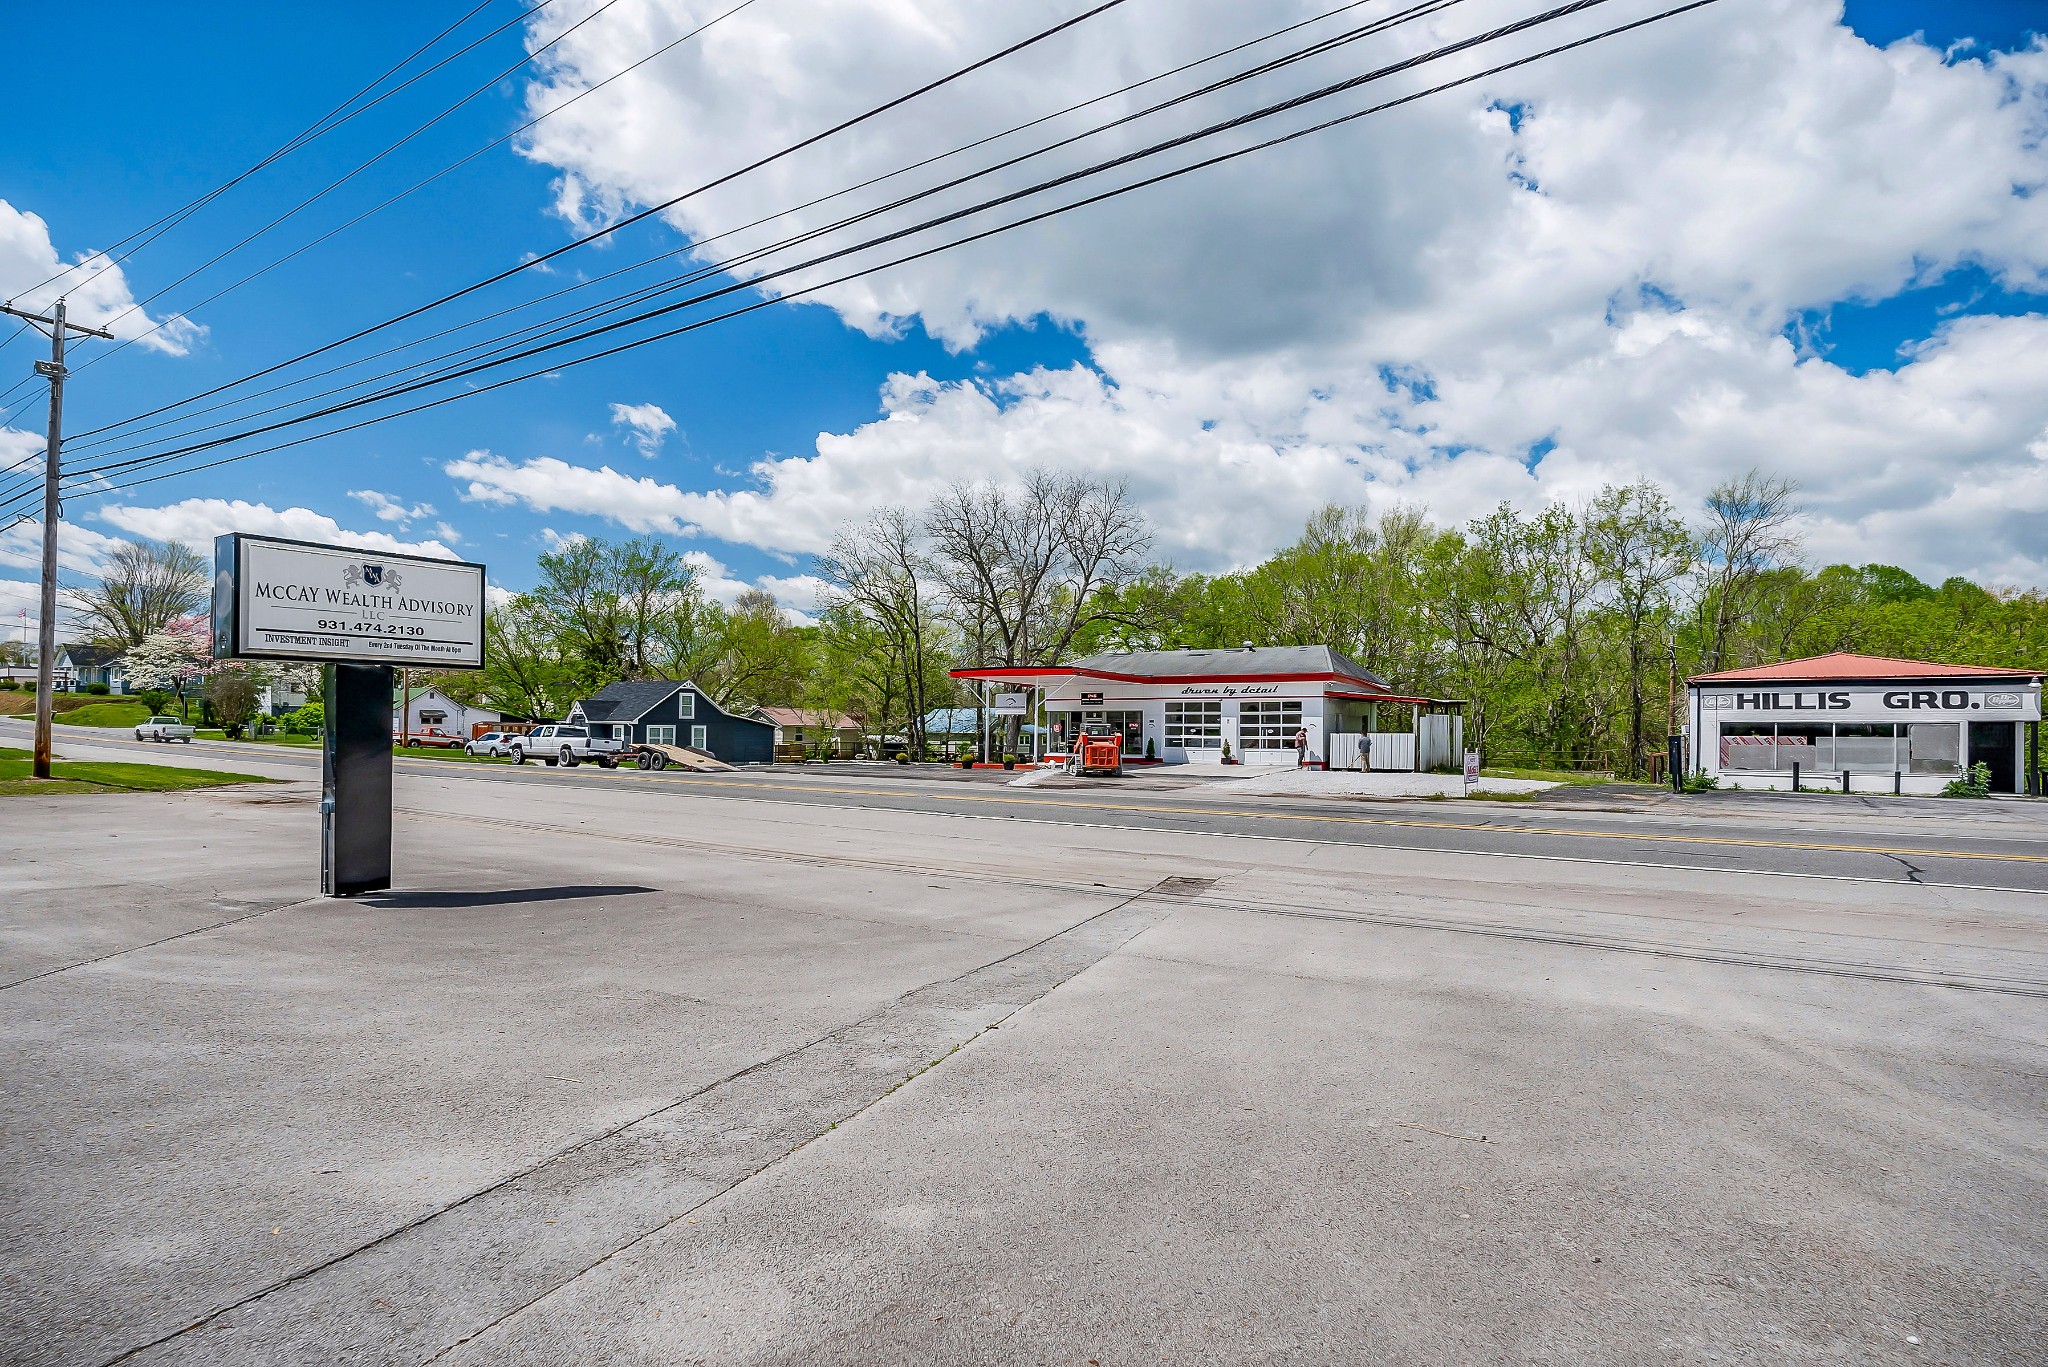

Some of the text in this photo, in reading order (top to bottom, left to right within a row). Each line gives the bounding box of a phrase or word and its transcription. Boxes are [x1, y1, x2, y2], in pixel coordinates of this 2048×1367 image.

[325, 588, 392, 610] WEALTH
[398, 596, 474, 617] ADVISORY
[362, 609, 385, 621] LLC
[317, 619, 425, 636] 931.474.2130
[264, 633, 350, 648] INVESTMENT INSIGHT
[394, 643, 414, 651] Tuesday
[1181, 685, 1279, 696] driven by detail
[1736, 691, 1851, 710] HILLIS
[1882, 690, 1980, 710] GRO.
